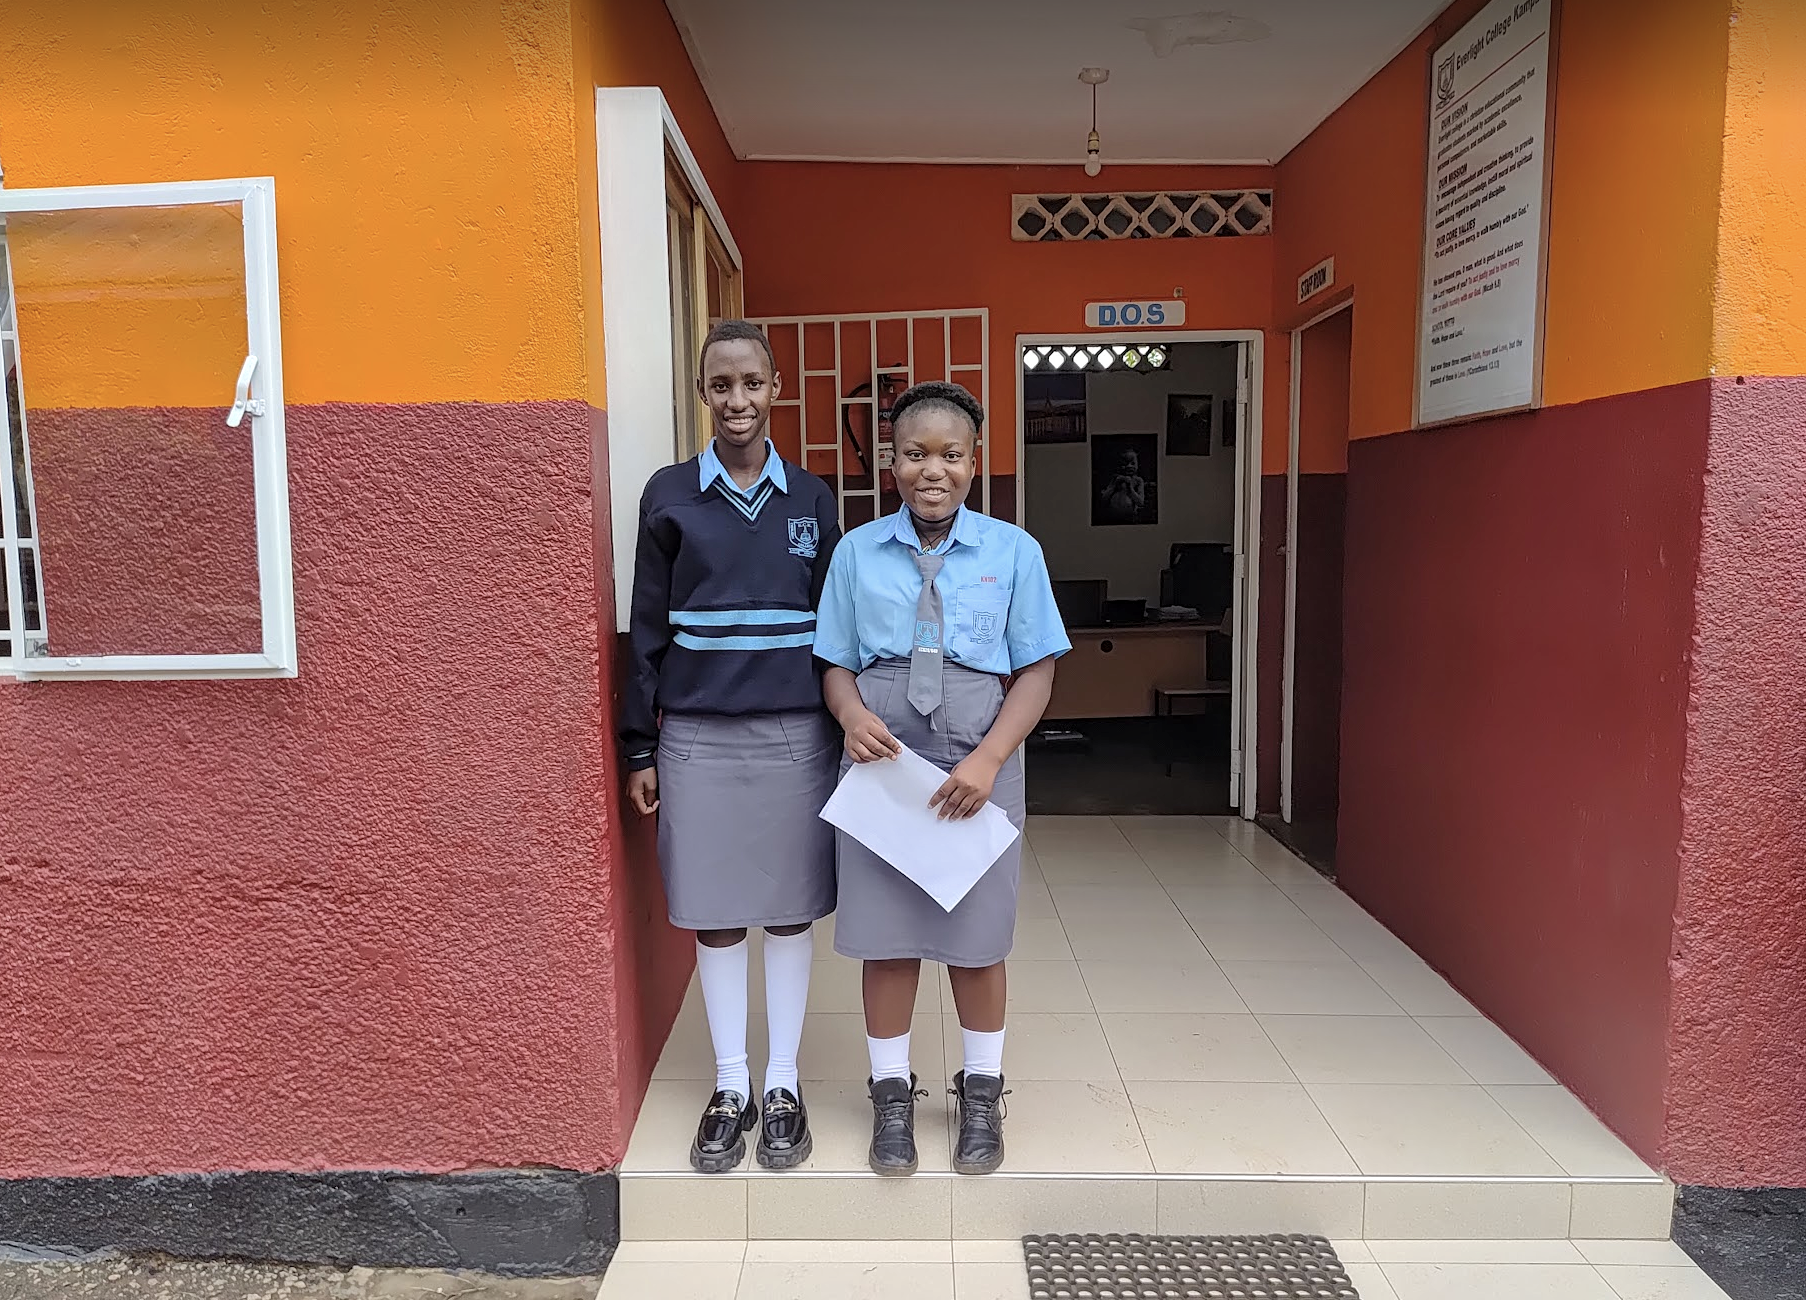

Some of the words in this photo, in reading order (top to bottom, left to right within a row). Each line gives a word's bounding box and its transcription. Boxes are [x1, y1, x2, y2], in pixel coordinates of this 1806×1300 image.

[1456, 36, 1484, 70] Everlight
[1486, 15, 1512, 46] College
[1449, 163, 1467, 182] MISSION
[1300, 274, 1314, 300] STAFF
[1313, 266, 1326, 292] ROOM
[1098, 303, 1164, 326] D.O.S
